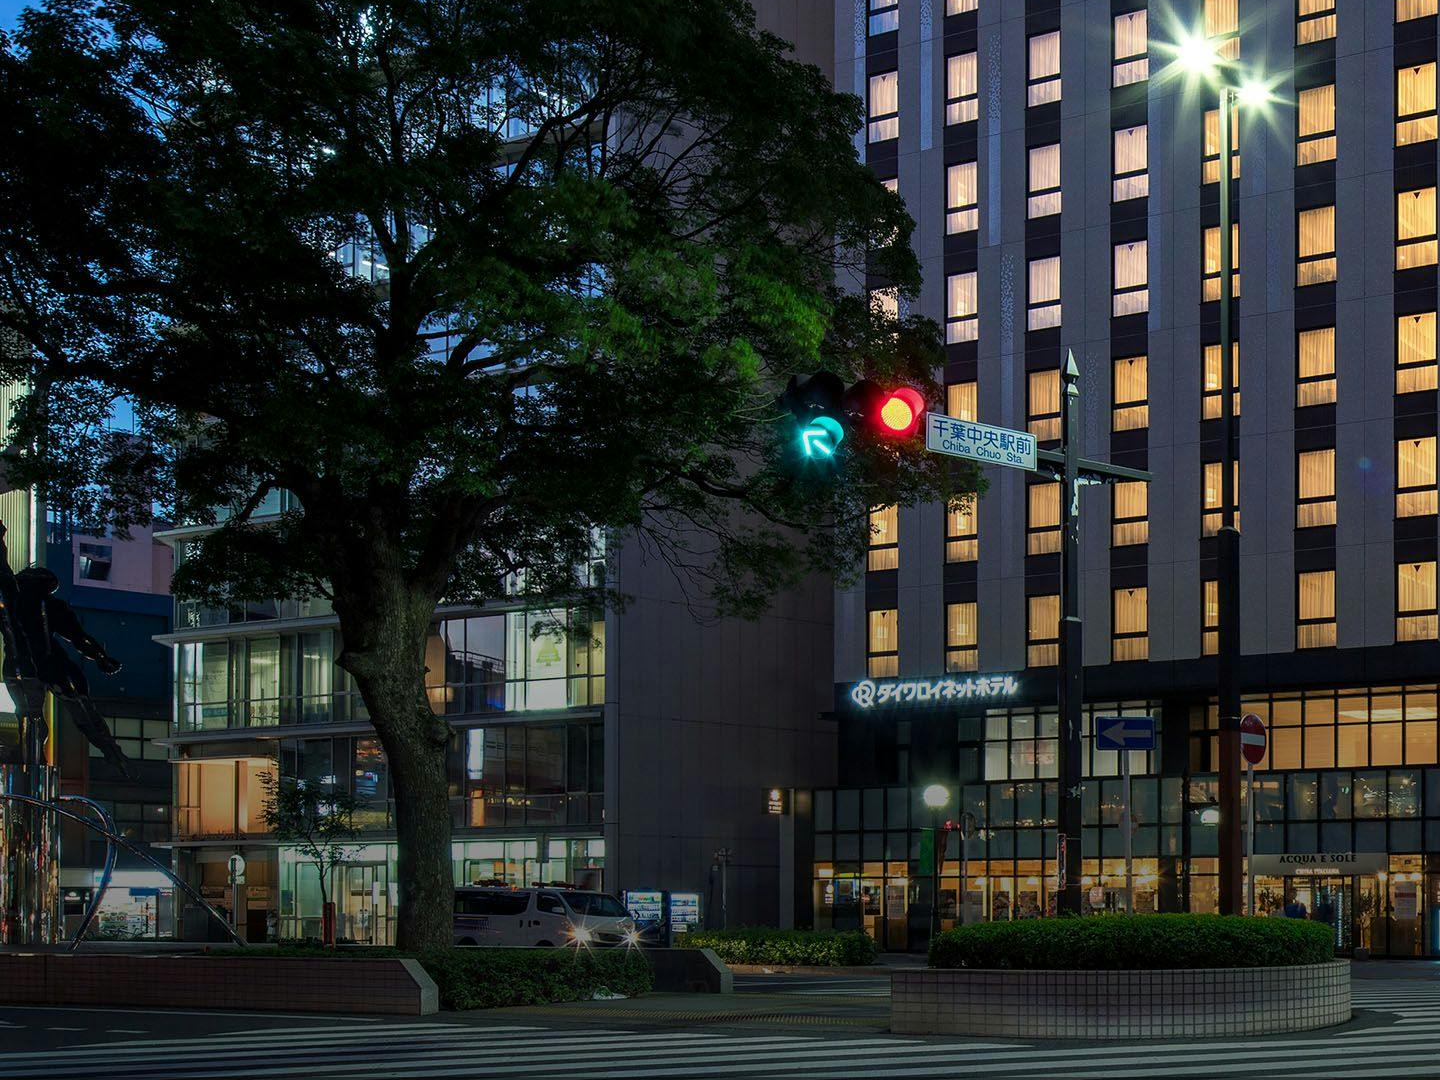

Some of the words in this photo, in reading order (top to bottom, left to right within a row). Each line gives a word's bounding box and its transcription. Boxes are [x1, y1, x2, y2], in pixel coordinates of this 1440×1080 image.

[933, 419, 1031, 455] 千葉中央駅前
[942, 439, 971, 454] Chiba
[976, 446, 1001, 460] Chuo
[1006, 452, 1024, 464] Sta.
[877, 676, 1018, 703] ダイワロイネットホテル
[1279, 855, 1316, 864] ACQUA
[1321, 854, 1327, 863] E
[1330, 854, 1358, 863] SOLE
